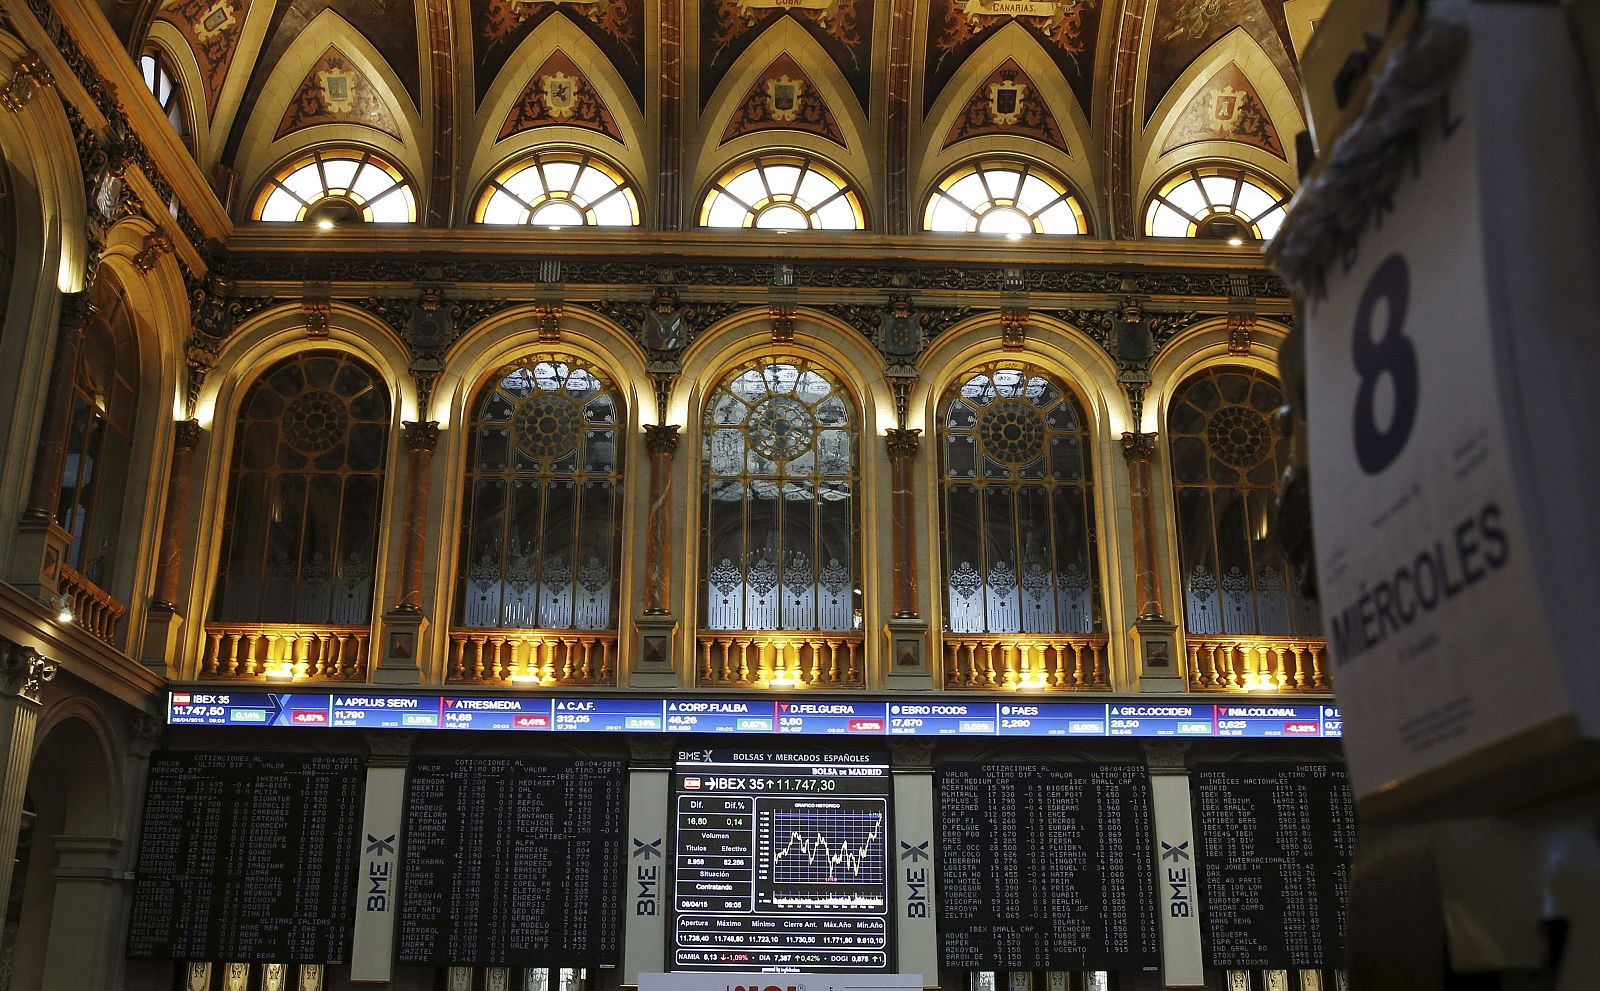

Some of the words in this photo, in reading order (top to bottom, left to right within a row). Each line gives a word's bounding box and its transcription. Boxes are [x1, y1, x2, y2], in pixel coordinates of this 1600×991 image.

[1352, 252, 1420, 476] 8
[1331, 503, 1510, 667] MIÉRCOLES
[193, 695, 216, 704] IBEX
[218, 695, 230, 704] 35
[345, 699, 385, 707] APPLUS
[386, 699, 417, 708] SERVI
[455, 700, 521, 710] ATRESMEDIA
[566, 702, 595, 711] C.A.F.
[791, 704, 854, 714] D.FELGUERA
[173, 706, 224, 716] 11.747,50
[901, 705, 930, 714] EBRO
[932, 705, 967, 715] FOODS
[1011, 706, 1038, 715] FAES
[1121, 707, 1191, 716] GR.C.OCCIDEN
[1228, 708, 1297, 717] INM.COLONIAL
[557, 714, 590, 724] 312,05
[780, 718, 802, 726] 3,80
[733, 753, 764, 761] BOLSAS
[767, 753, 773, 761] Y
[775, 753, 820, 762] MERCADOS
[823, 753, 870, 762] ESPAÑOLES
[848, 768, 882, 776] MADRID
[716, 778, 746, 790] IBEX
[749, 779, 765, 790] 35
[776, 779, 836, 793] 11.747,30
[724, 801, 745, 809] Dif.%
[686, 818, 707, 826] 16,80
[726, 818, 743, 826] 0,14
[699, 870, 730, 878] Situación
[367, 861, 388, 912] BME
[636, 865, 656, 916] BME
[695, 883, 733, 891] Contratando
[906, 868, 926, 918] BME
[1168, 868, 1189, 918] BME
